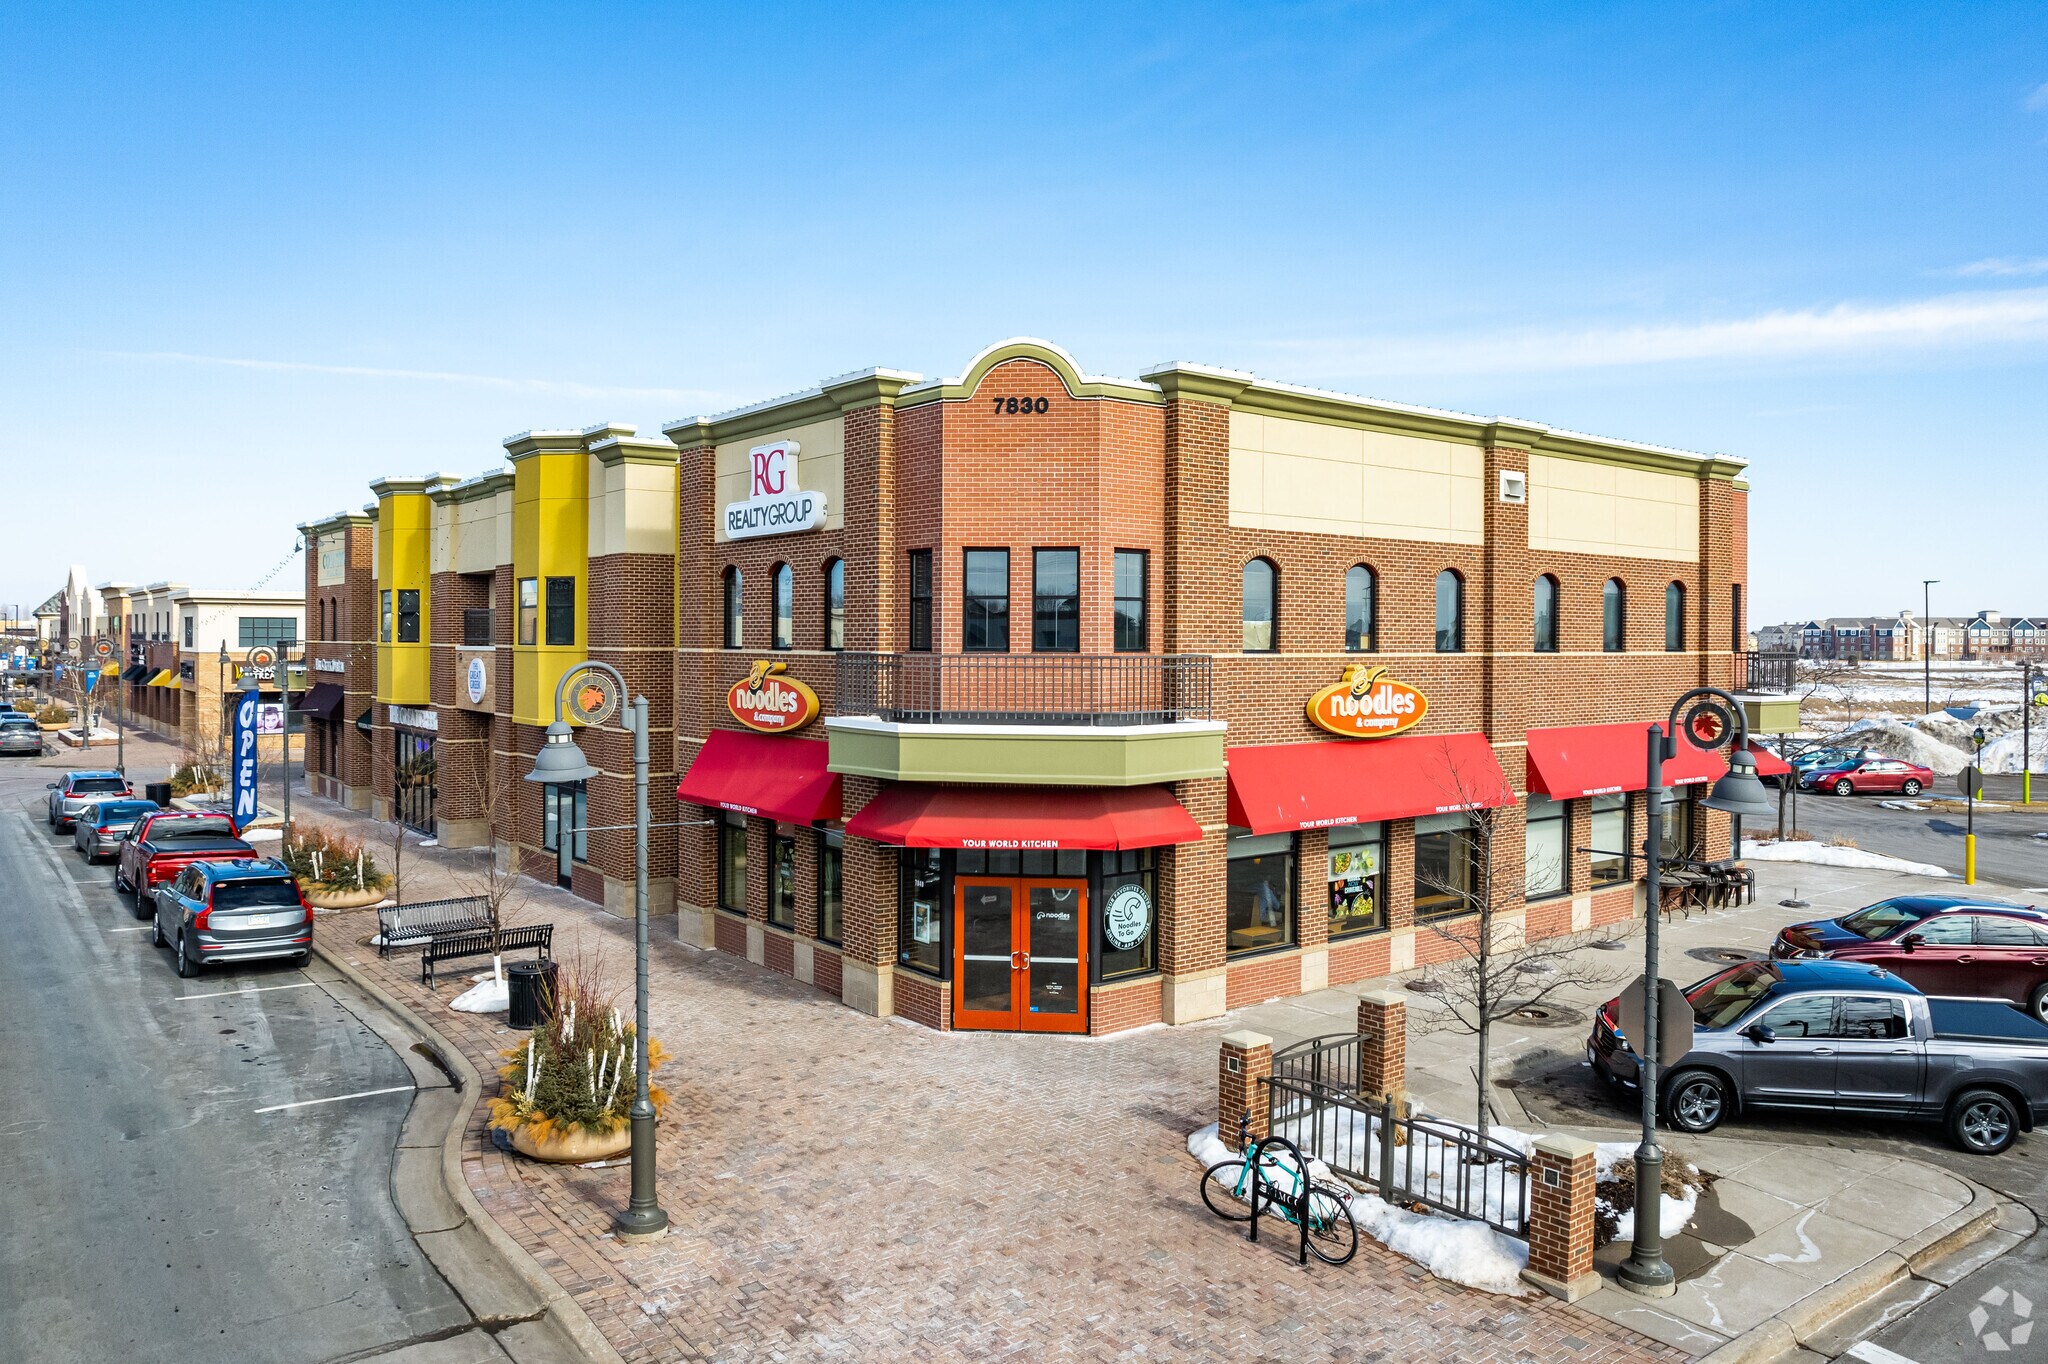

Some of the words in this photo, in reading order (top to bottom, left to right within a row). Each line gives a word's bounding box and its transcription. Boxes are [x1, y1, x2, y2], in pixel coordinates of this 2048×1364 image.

[993, 396, 1049, 415] 7830
[753, 449, 785, 496] RG
[573, 677, 610, 695] ARBOR
[736, 681, 798, 713] noodles
[1331, 685, 1415, 717] noodles
[573, 704, 612, 721] LAKES
[1363, 717, 1399, 729] company
[236, 700, 256, 816] OPEN
[1300, 821, 1315, 829] YOUR
[1316, 818, 1334, 827] WORLD
[1335, 816, 1358, 825] KITCHEN
[962, 839, 987, 848] YOUR
[989, 840, 1019, 848] WORLD
[1021, 840, 1058, 848] KITCHEN
[1105, 897, 1115, 916] YOUR
[1046, 912, 1070, 920] noodles
[1117, 920, 1142, 930] Noodles
[1106, 928, 1122, 948] ONLINE
[1124, 941, 1135, 949] APP
